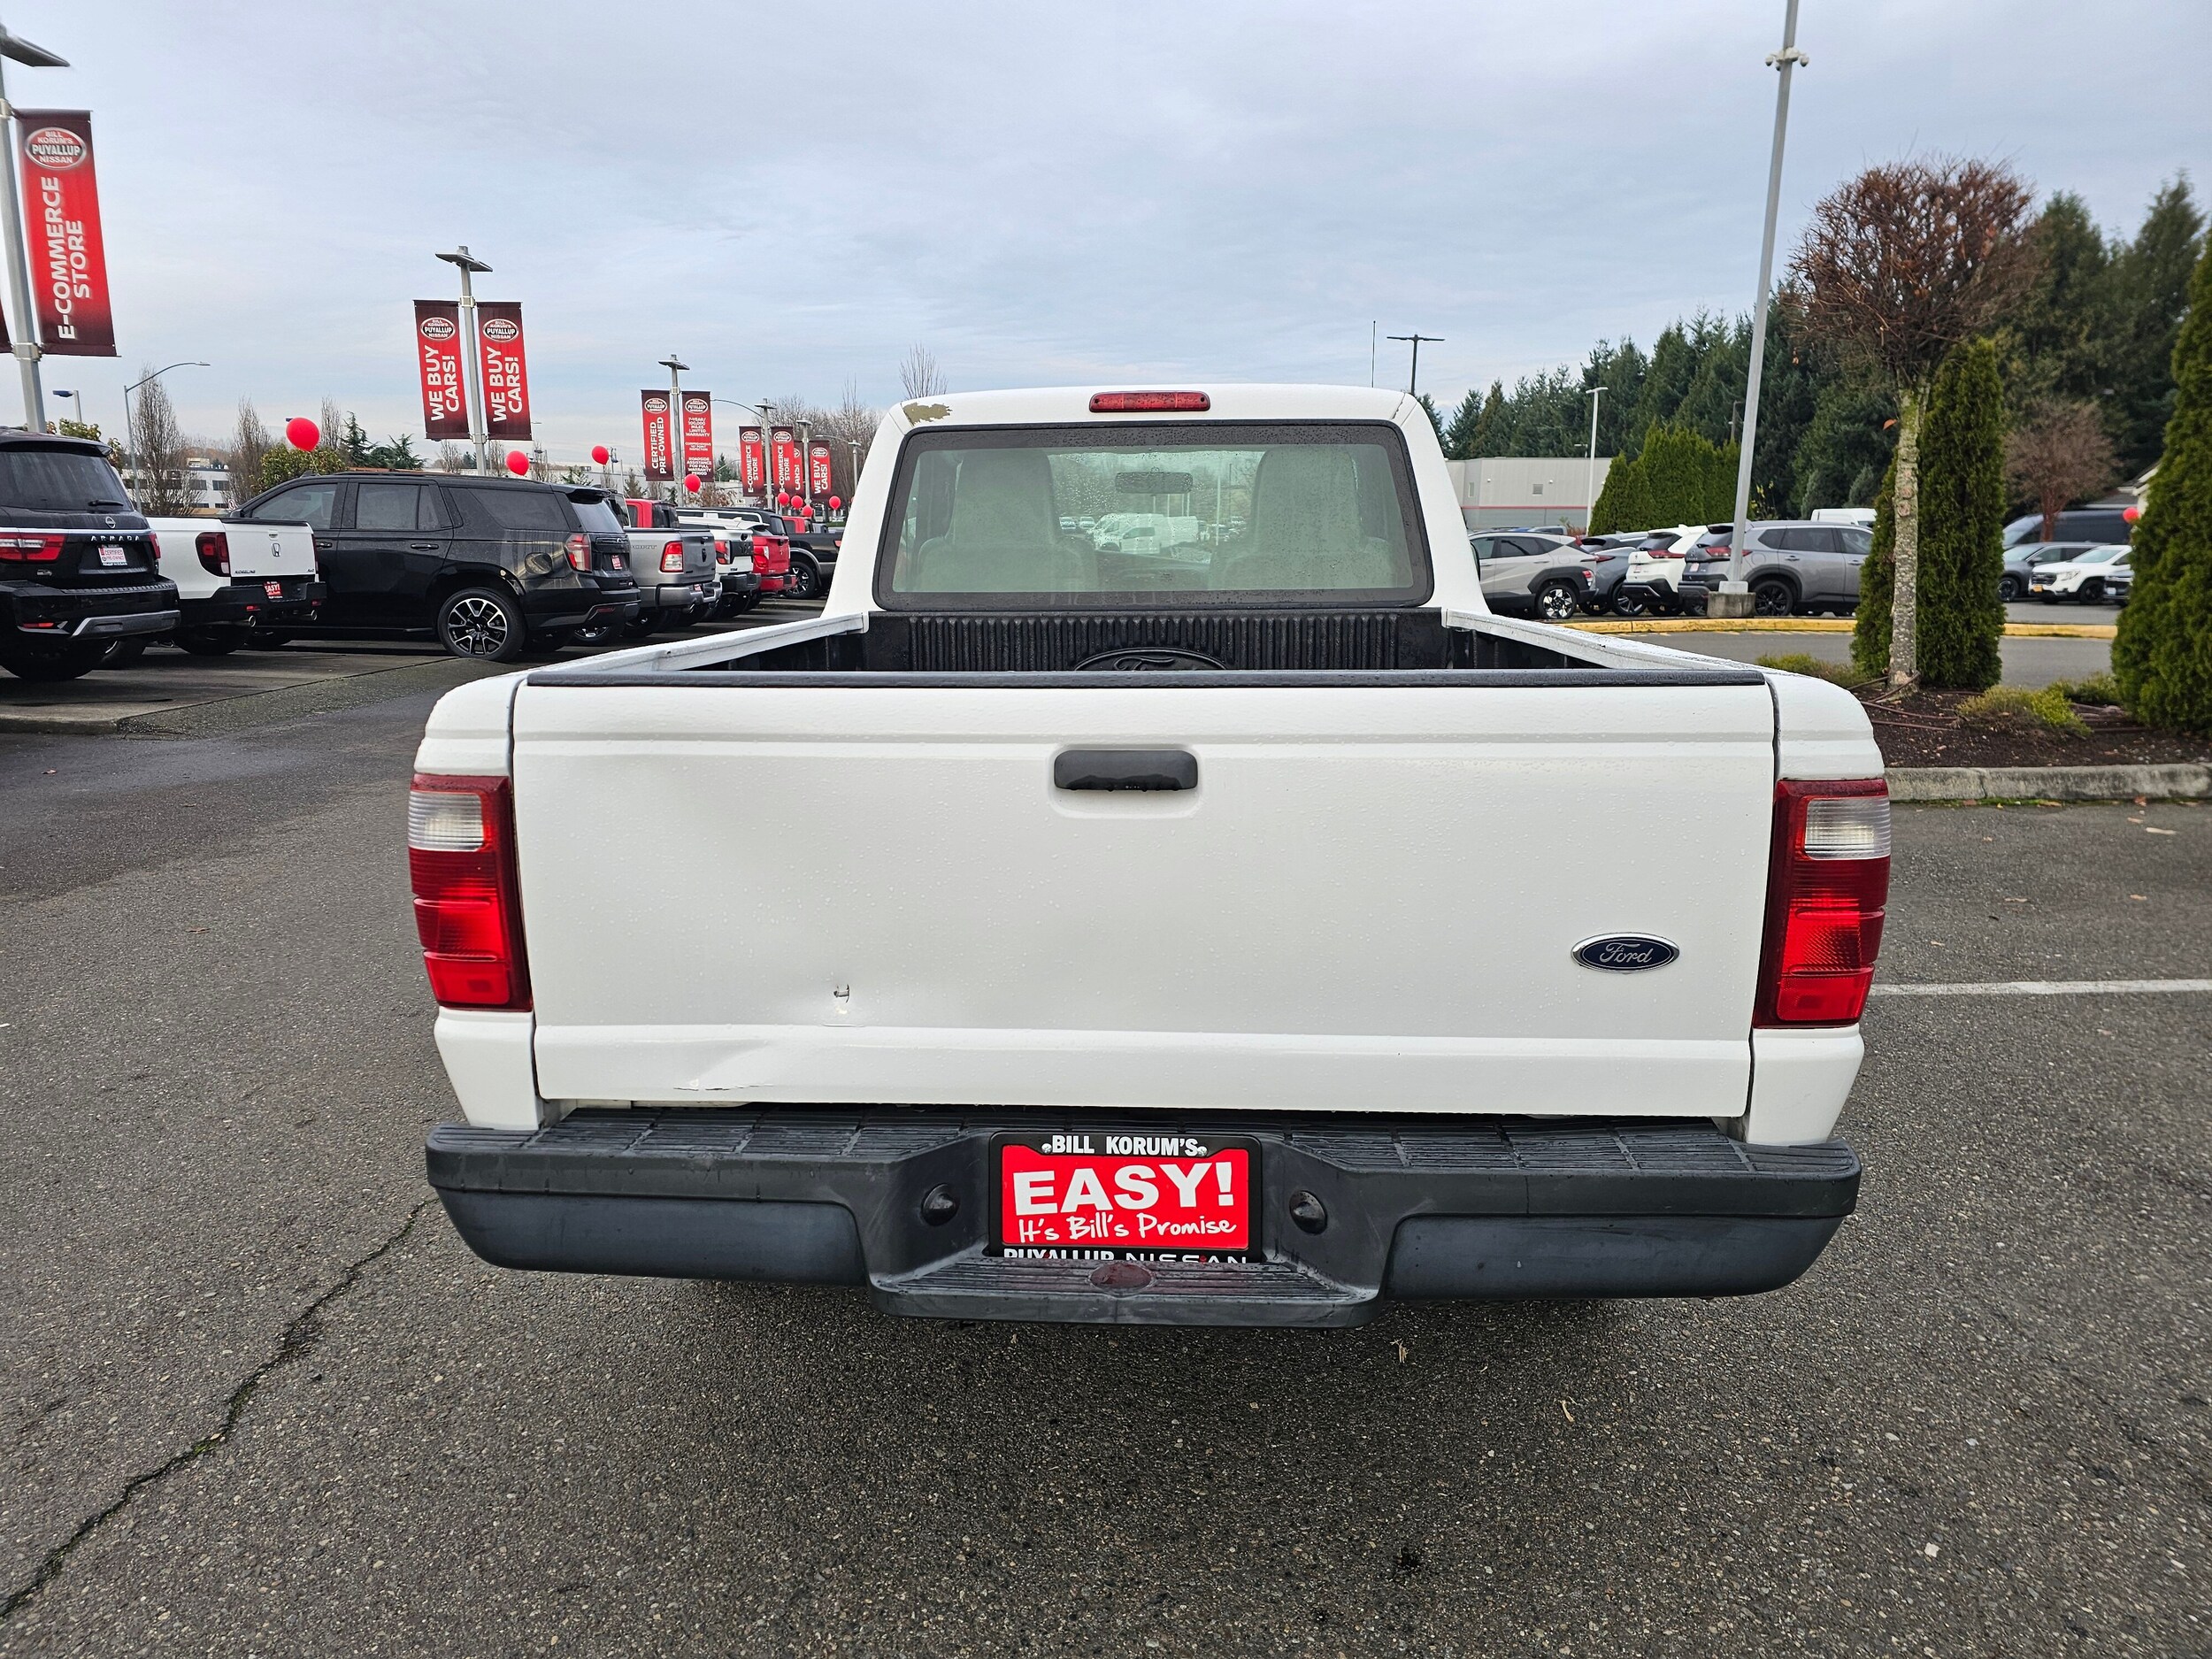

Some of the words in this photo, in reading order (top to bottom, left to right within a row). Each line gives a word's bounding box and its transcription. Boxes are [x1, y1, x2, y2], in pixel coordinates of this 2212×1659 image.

[32, 144, 81, 156] PUYALLUP
[41, 177, 74, 339] E-COMMERCE
[66, 220, 89, 298] STORE
[425, 345, 442, 386] BUY
[487, 346, 504, 387] BUY
[442, 356, 459, 412] CARS!
[504, 357, 522, 413] CARS!
[427, 391, 444, 421] WE
[491, 391, 508, 422] WE
[657, 417, 667, 474] PRE-OWNED
[814, 480, 821, 494] WE
[264, 584, 281, 593] EASY!
[1599, 942, 1654, 964] Ford
[1051, 1135, 1094, 1154] BILL
[1106, 1136, 1198, 1156] KORUM'S
[1012, 1161, 1233, 1216] EASY!
[1019, 1218, 1060, 1243] It's
[1067, 1211, 1129, 1240] Bill's
[1136, 1211, 1237, 1239] Promise
